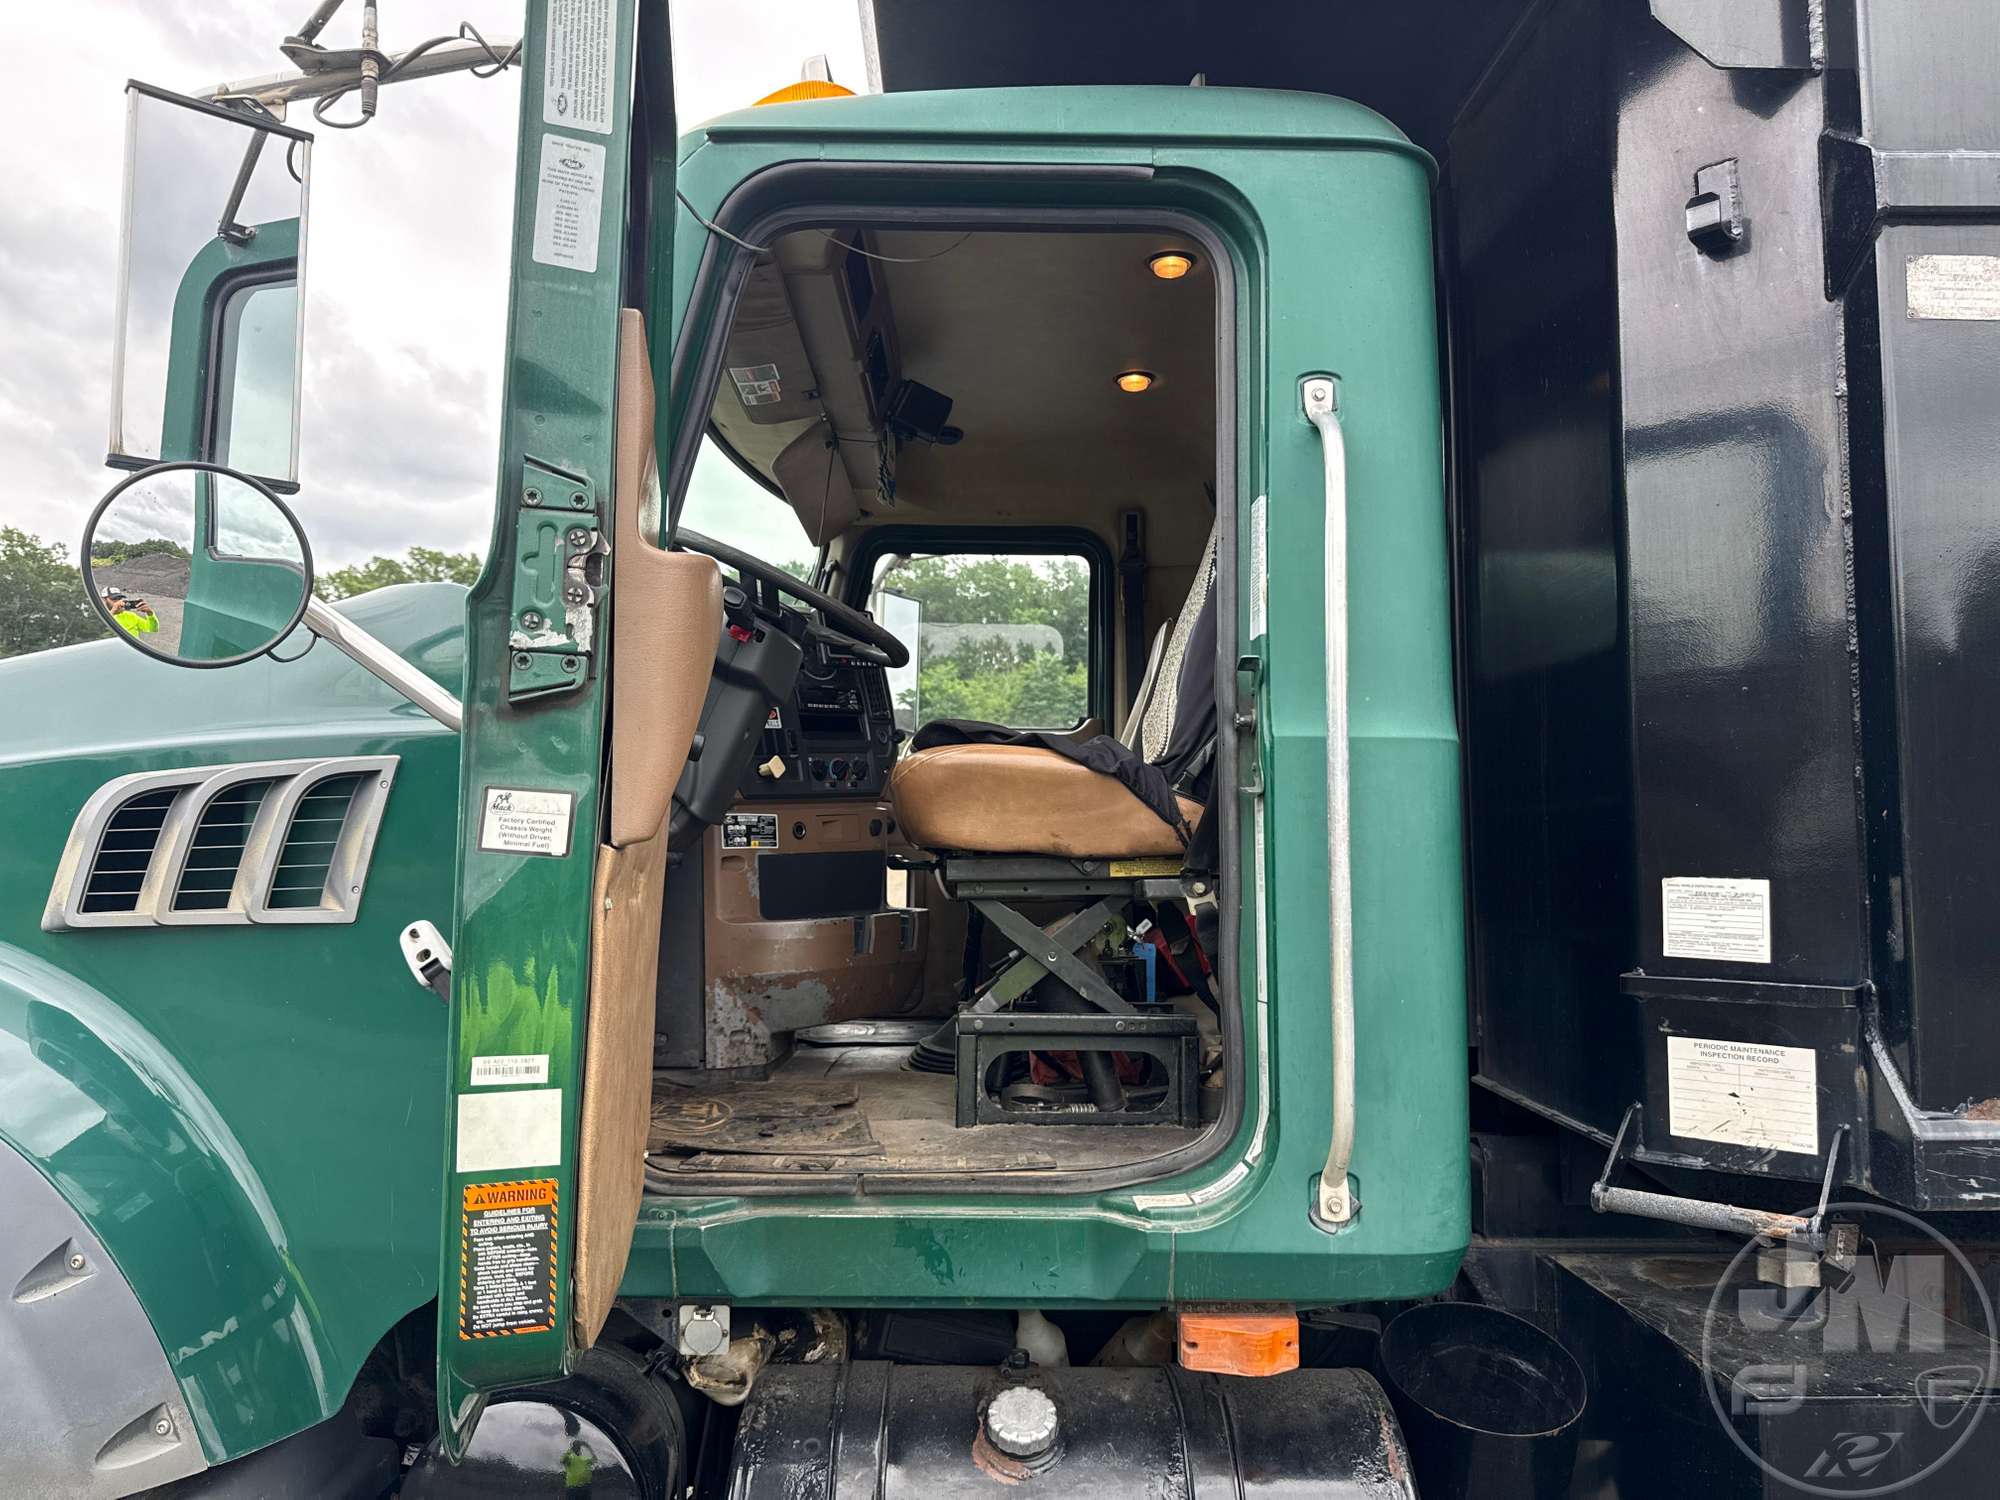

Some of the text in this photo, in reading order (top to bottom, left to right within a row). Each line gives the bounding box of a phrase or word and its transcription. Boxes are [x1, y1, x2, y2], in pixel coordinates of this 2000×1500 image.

[498, 816, 556, 826] Factory Certified
[498, 832, 528, 840] (Without
[529, 826, 553, 834] Weight
[504, 839, 550, 849] Minimal Fuel)
[1694, 1042, 1786, 1057] PERIODIC MAINTENANCE
[1700, 1050, 1780, 1064] INSPECTION RECORD
[487, 1188, 546, 1203] WARNING
[483, 1206, 536, 1218] GUIDELINES FOR
[473, 1214, 545, 1227] ENTERING AND EXITING
[470, 1222, 548, 1236] TO AVOID SERIOUS INJURY
